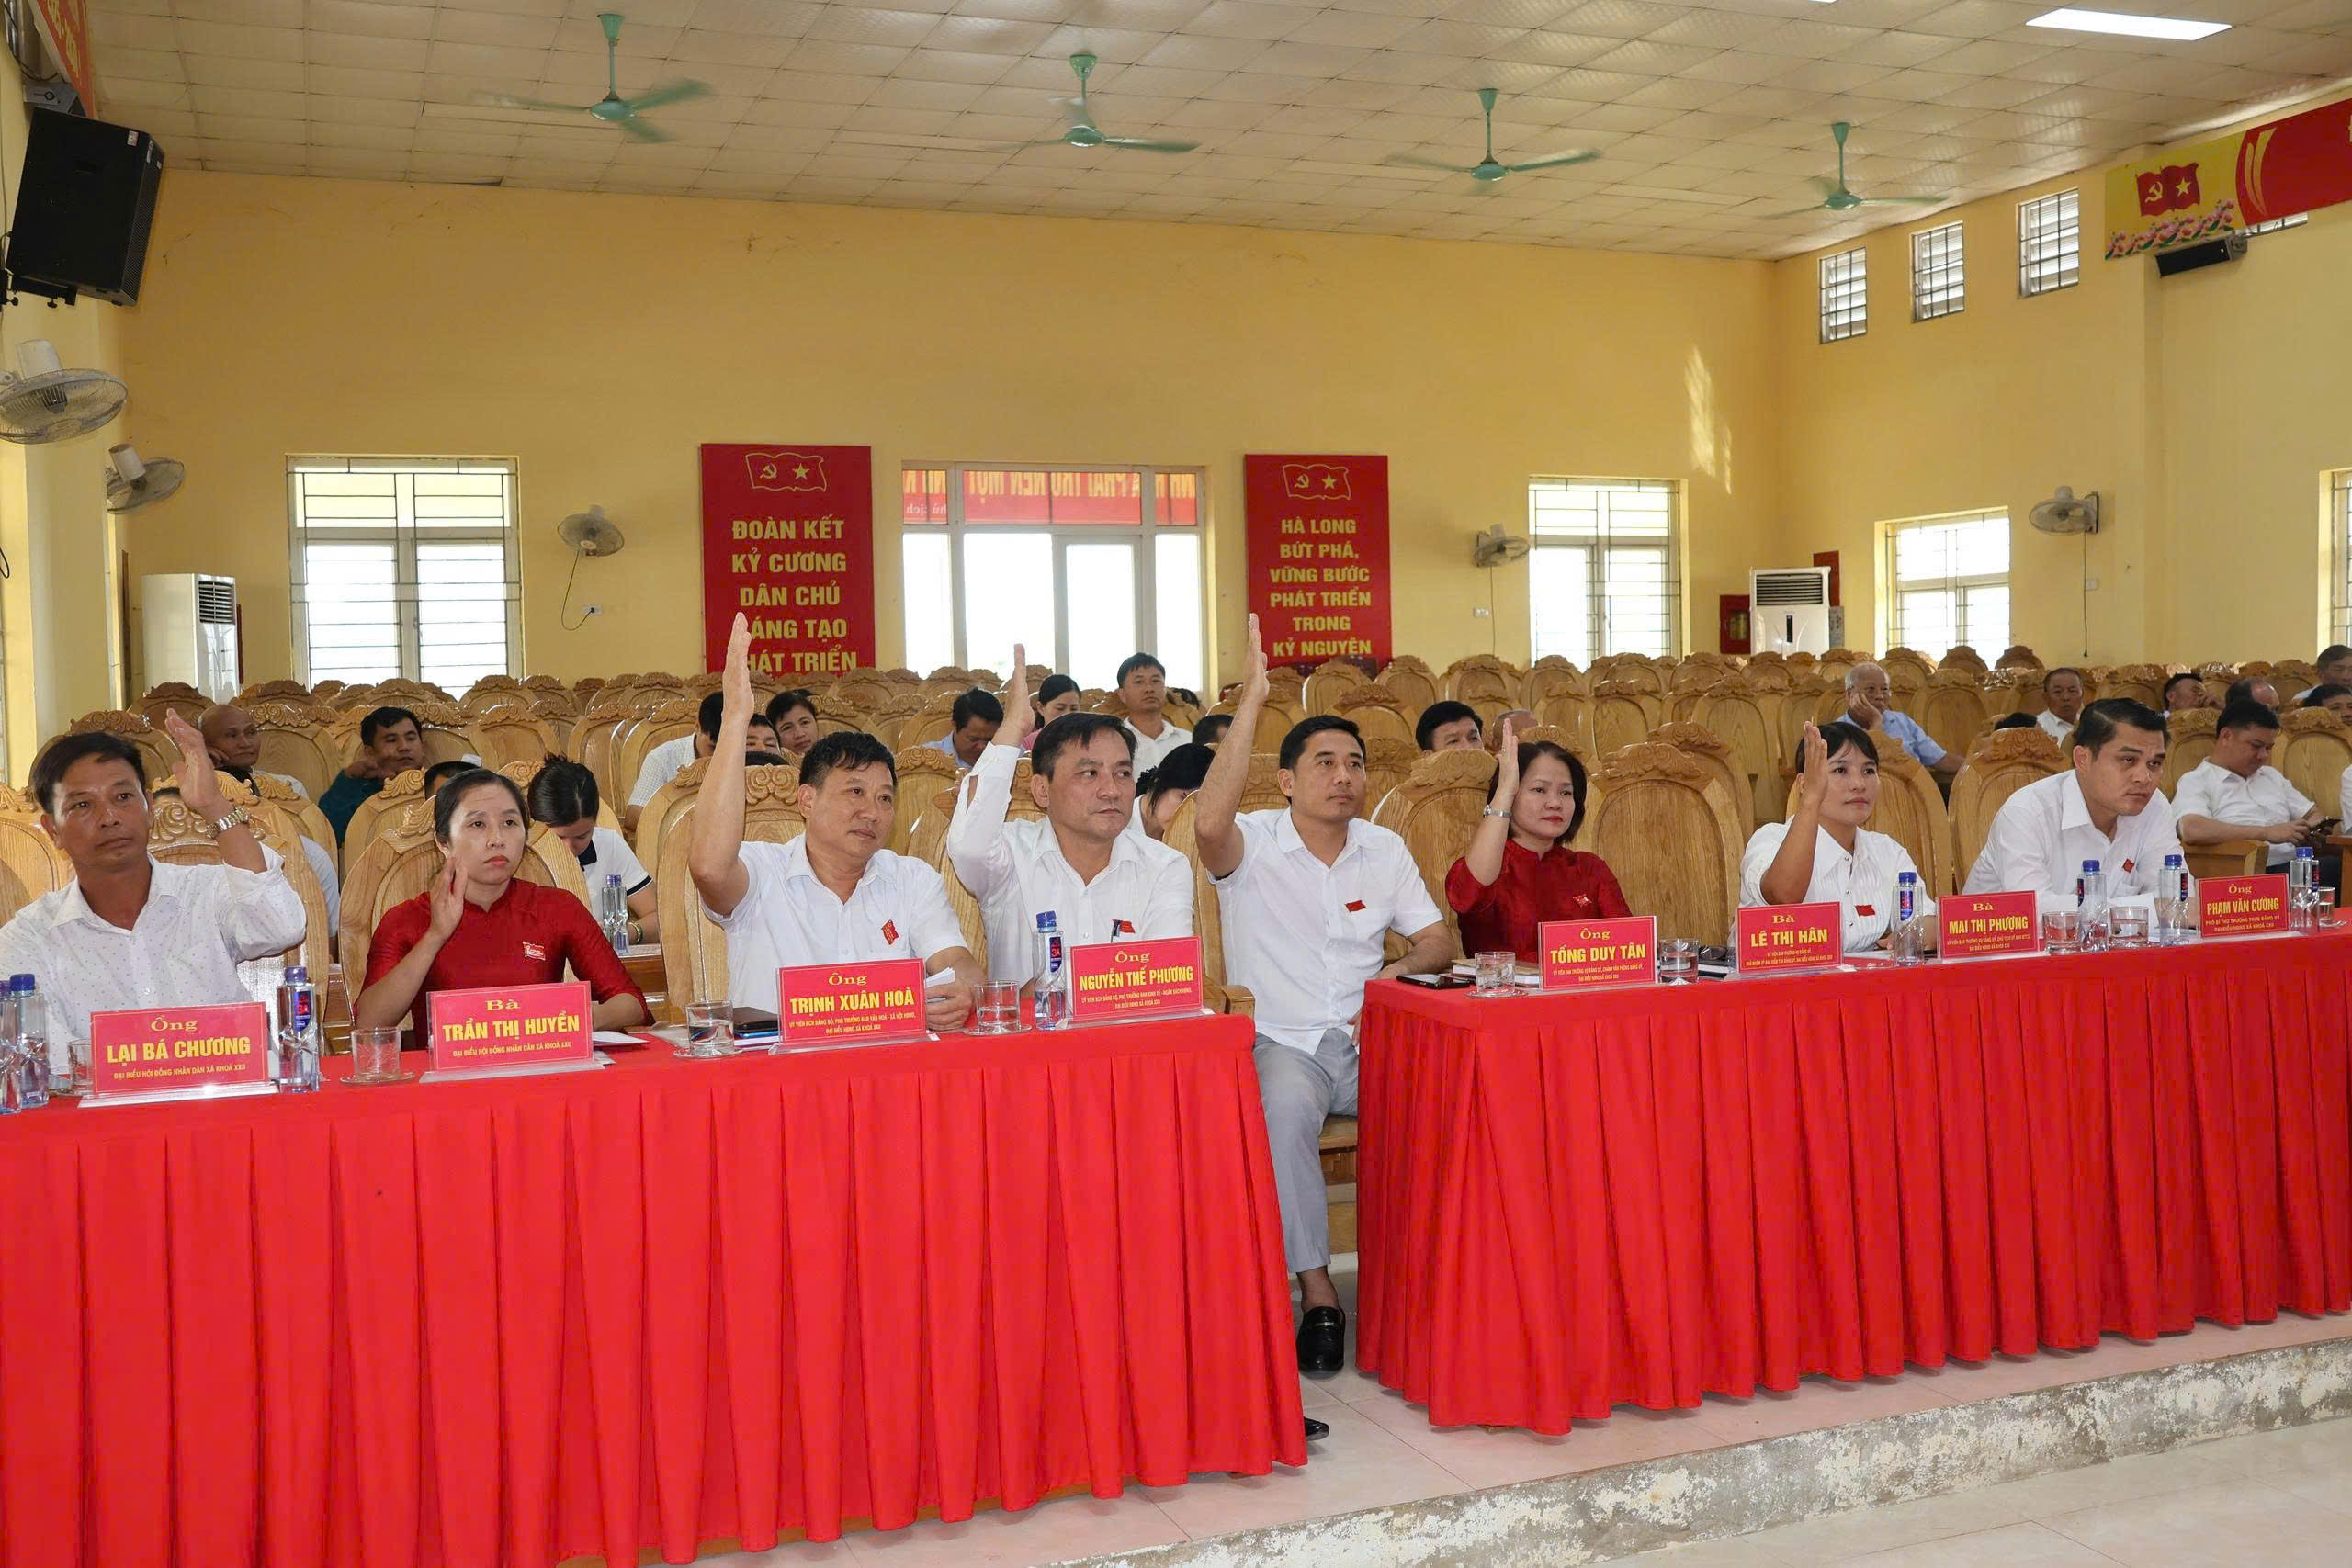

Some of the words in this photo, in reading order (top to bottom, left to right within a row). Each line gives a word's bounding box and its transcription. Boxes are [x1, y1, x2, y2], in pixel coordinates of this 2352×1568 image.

[732, 516, 797, 540] ĐOÀN
[804, 514, 845, 539] KẾT
[1281, 516, 1306, 534] HÀ
[1310, 519, 1356, 534] LONG
[731, 547, 762, 573] KỶ
[769, 551, 847, 573] CƯƠNG
[1279, 541, 1314, 558] BỨT
[1318, 541, 1360, 559] PHÁ,
[1270, 566, 1318, 583] VỮNG
[1323, 565, 1370, 582] BƯỚC
[740, 583, 787, 607] DÂN
[795, 580, 841, 606] CHỦ
[1270, 590, 1316, 607] PHÁT
[1321, 586, 1372, 607] TRIỂN
[751, 616, 797, 640] ÁNG
[804, 618, 847, 643] TẠO
[1293, 616, 1351, 632] TRONG
[1272, 637, 1295, 657] KỶ
[1301, 637, 1372, 657] NGUYÊN
[747, 649, 785, 672] HÁT
[791, 644, 857, 672] TRIỂN
[2228, 884, 2252, 894] Ông
[1973, 903, 1994, 912] Bà
[2207, 901, 2232, 917] PHẠM
[2233, 898, 2250, 913] VĂN
[2251, 897, 2279, 911] CƯỜNG
[1772, 915, 1794, 924] Bà
[1949, 920, 1968, 934] MAI
[1971, 919, 1986, 934] THỊ
[1989, 916, 2029, 932] PHƯỢNG
[1580, 928, 1611, 940] Ông
[1750, 930, 1768, 947] LÊ
[1771, 931, 1794, 947] THỊ
[1798, 927, 1828, 944] HÂN
[1114, 951, 1150, 963] Ông
[1550, 944, 1587, 964] TỐNG
[1590, 946, 1616, 962] DUY
[1620, 942, 1646, 960] TÂN
[828, 972, 867, 986] Ông
[1080, 967, 1123, 991] NGUYỄN
[1126, 965, 1147, 986] THẾ
[1149, 965, 1193, 984] PHƯƠNG
[485, 999, 521, 1011] Bà
[790, 996, 835, 1017] TRỊNH
[840, 990, 880, 1010] XUÂN
[885, 987, 915, 1007] HOÀ
[151, 1014, 198, 1032] Ông
[442, 1017, 489, 1042] TRẦN
[492, 1019, 520, 1041] THỊ
[525, 1010, 580, 1035] HUYỀN
[107, 1043, 137, 1066] LẠI
[143, 1038, 169, 1060] BÁ
[174, 1036, 251, 1059] CHƯƠNG
